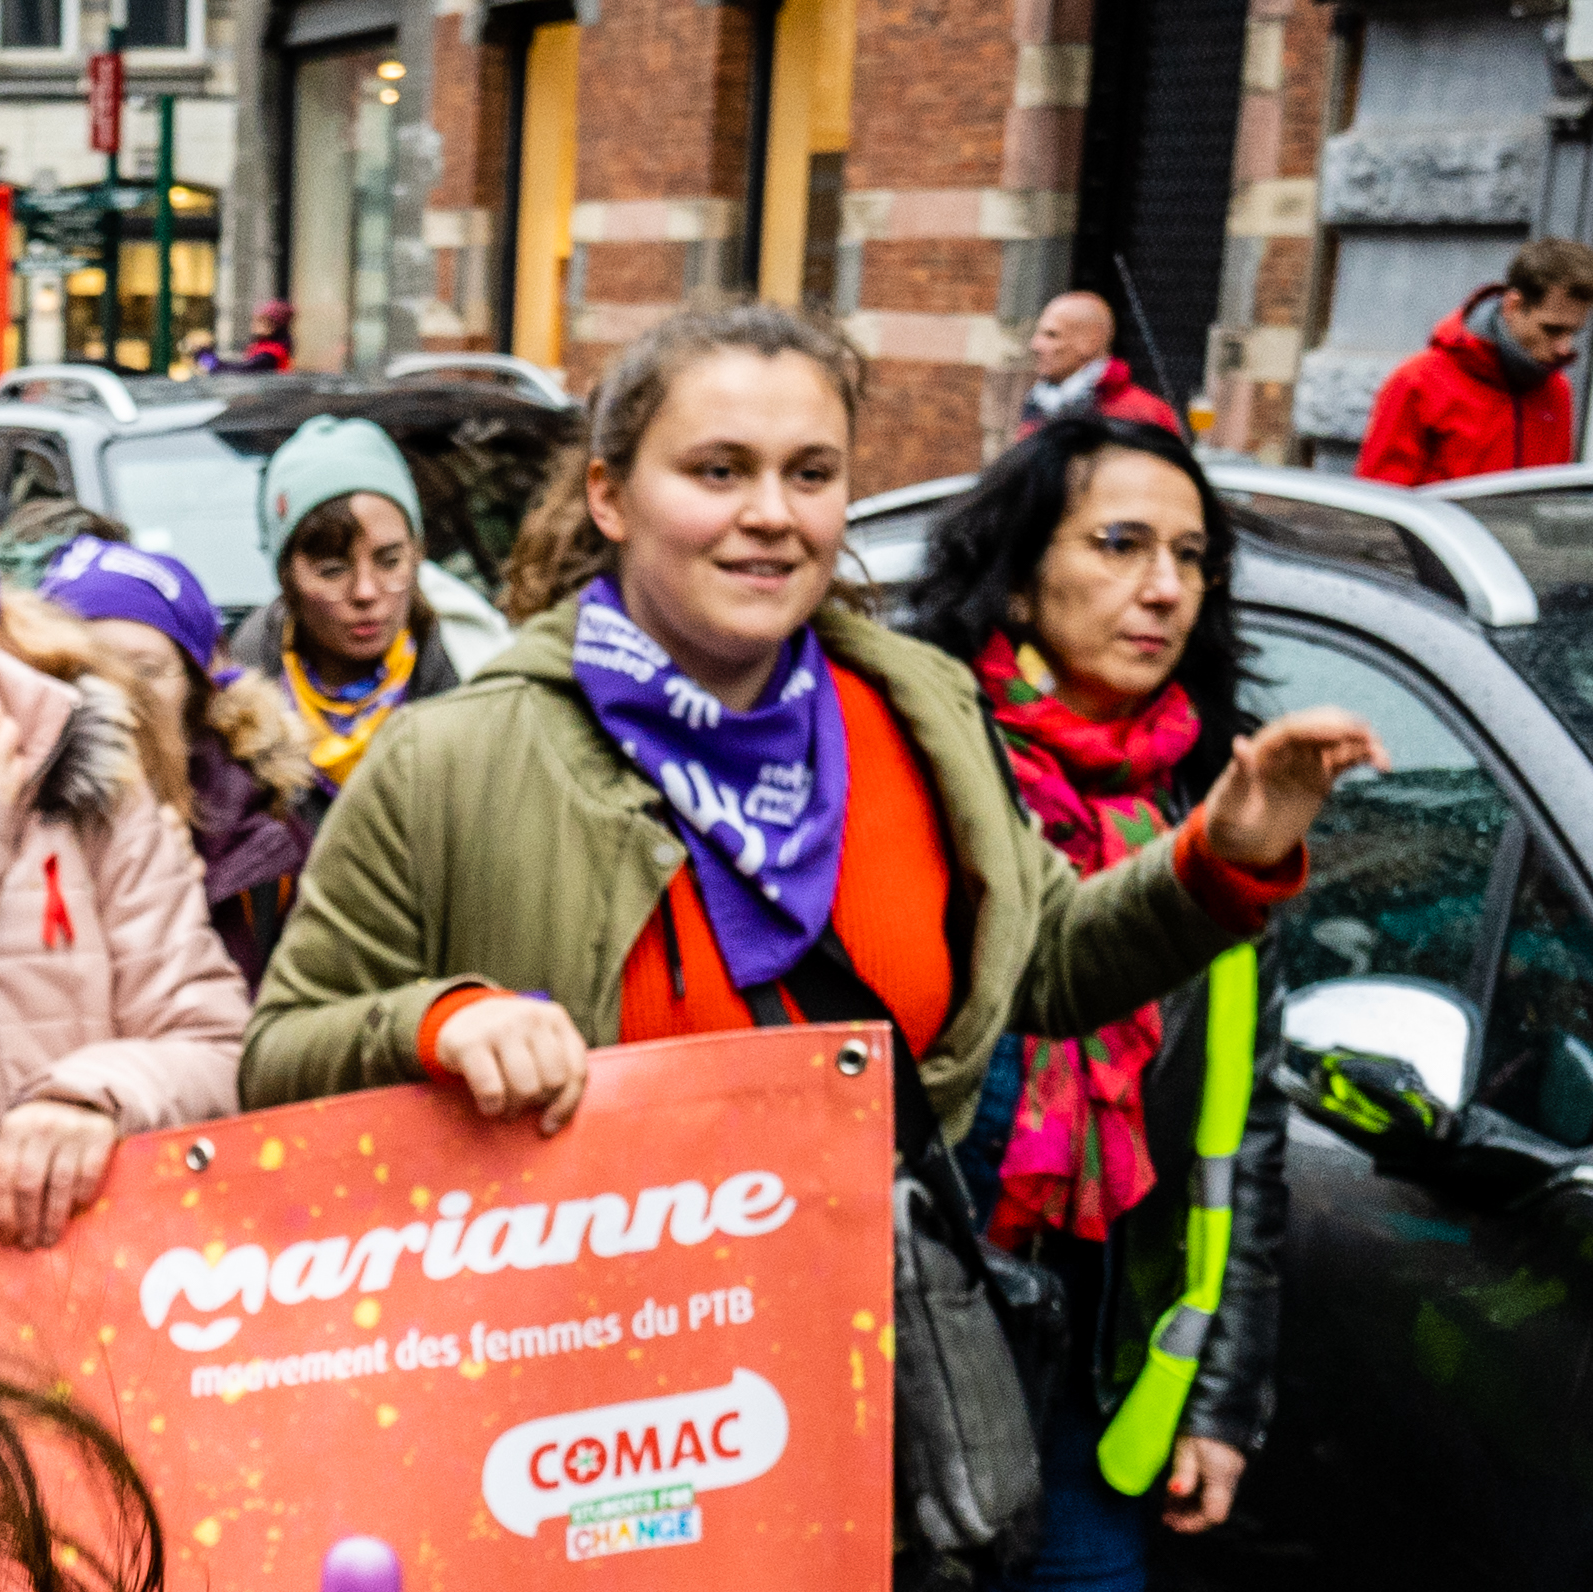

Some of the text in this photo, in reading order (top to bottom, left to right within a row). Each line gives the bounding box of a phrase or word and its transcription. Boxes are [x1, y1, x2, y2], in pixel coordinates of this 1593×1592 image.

[190, 1285, 755, 1398] mouvement des femmes du PTB
[529, 1411, 741, 1490] COMAC
[573, 1510, 693, 1557] CHANGE
